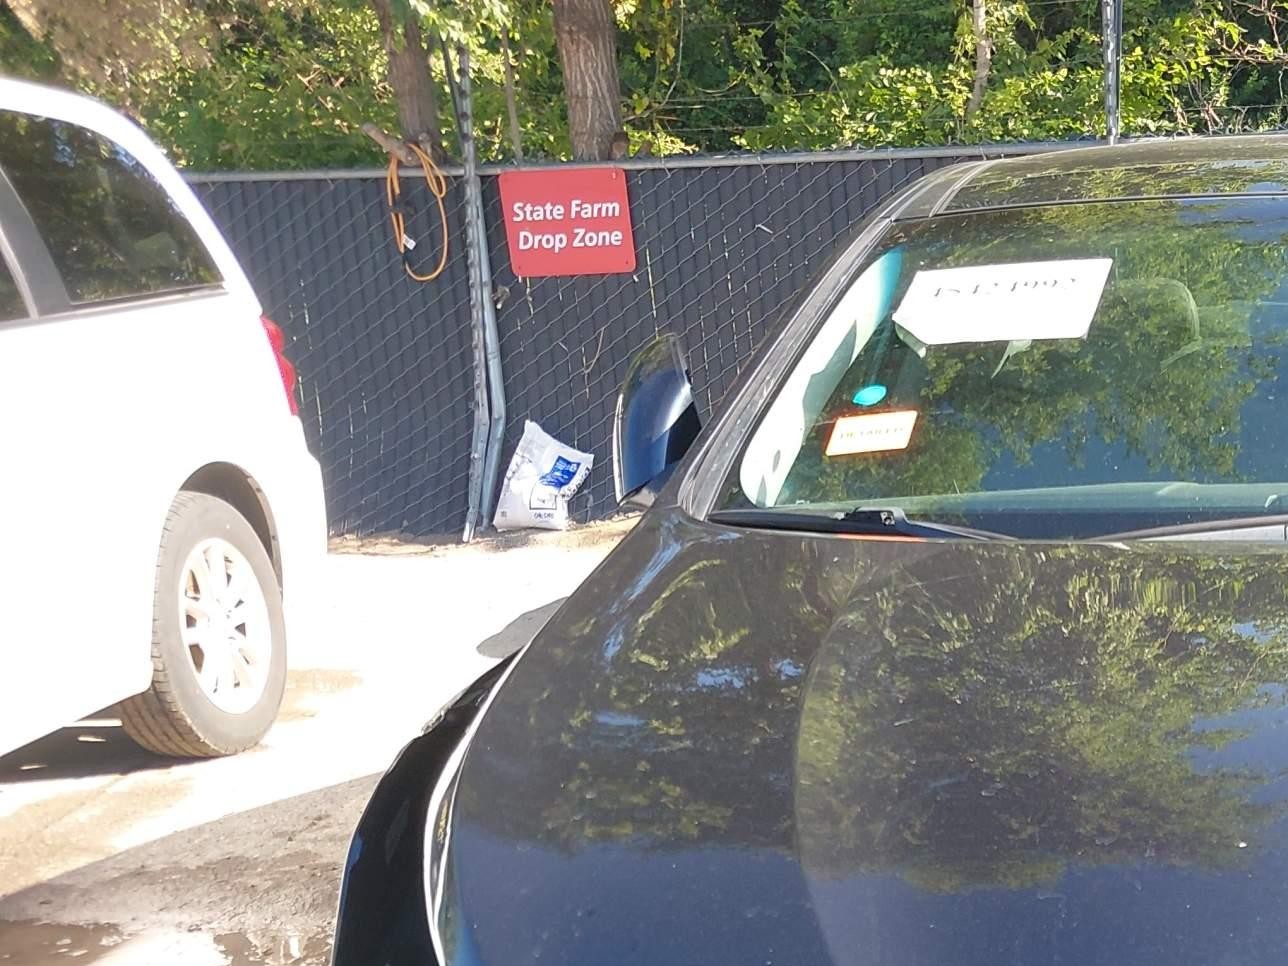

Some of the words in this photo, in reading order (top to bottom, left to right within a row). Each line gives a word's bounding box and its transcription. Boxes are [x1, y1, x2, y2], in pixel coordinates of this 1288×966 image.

[512, 202, 565, 222] State
[570, 199, 620, 219] Farm
[518, 230, 567, 253] Drop
[572, 228, 623, 247] Zone
